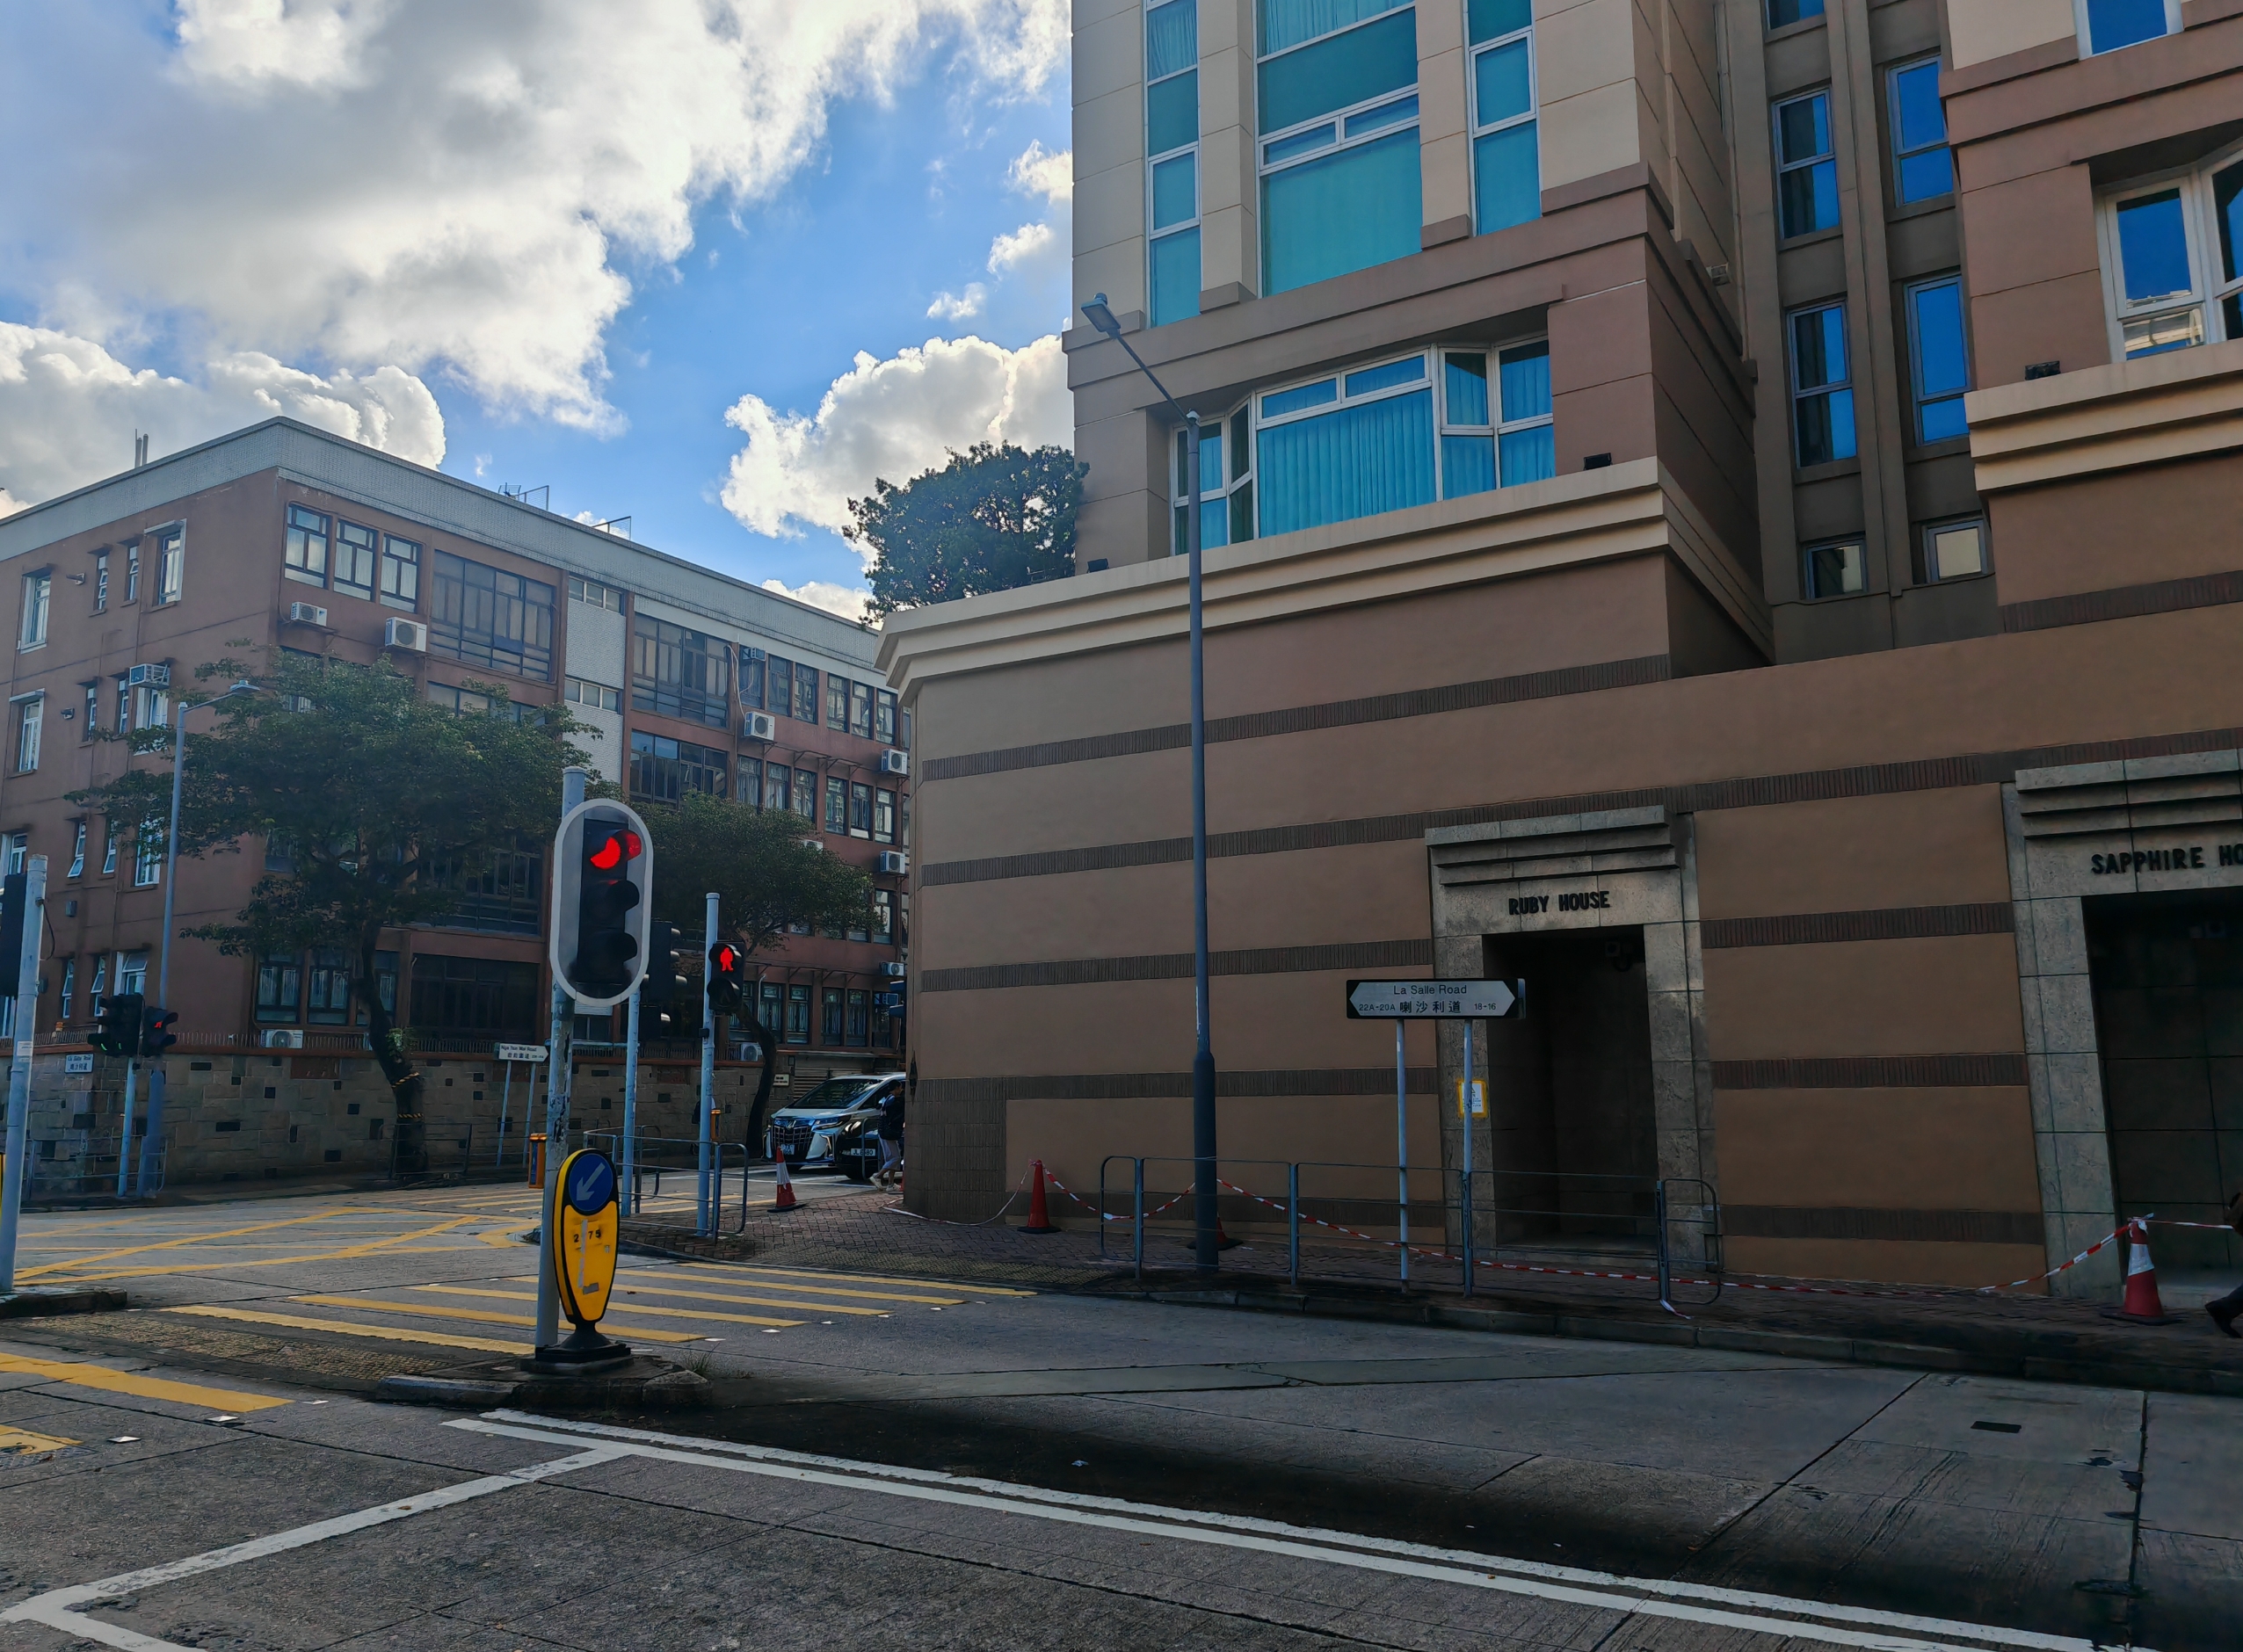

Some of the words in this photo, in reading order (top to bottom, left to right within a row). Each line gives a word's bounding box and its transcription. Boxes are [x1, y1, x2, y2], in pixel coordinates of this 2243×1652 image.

[2091, 846, 2205, 874] SAPPHIRE
[1508, 895, 1550, 916] RUBY
[1558, 890, 1610, 911] HOUSE
[1393, 985, 1407, 995] La
[1411, 984, 1435, 995] Salle
[1439, 984, 1467, 995] Road
[1399, 1000, 1462, 1014] 喇沙利道
